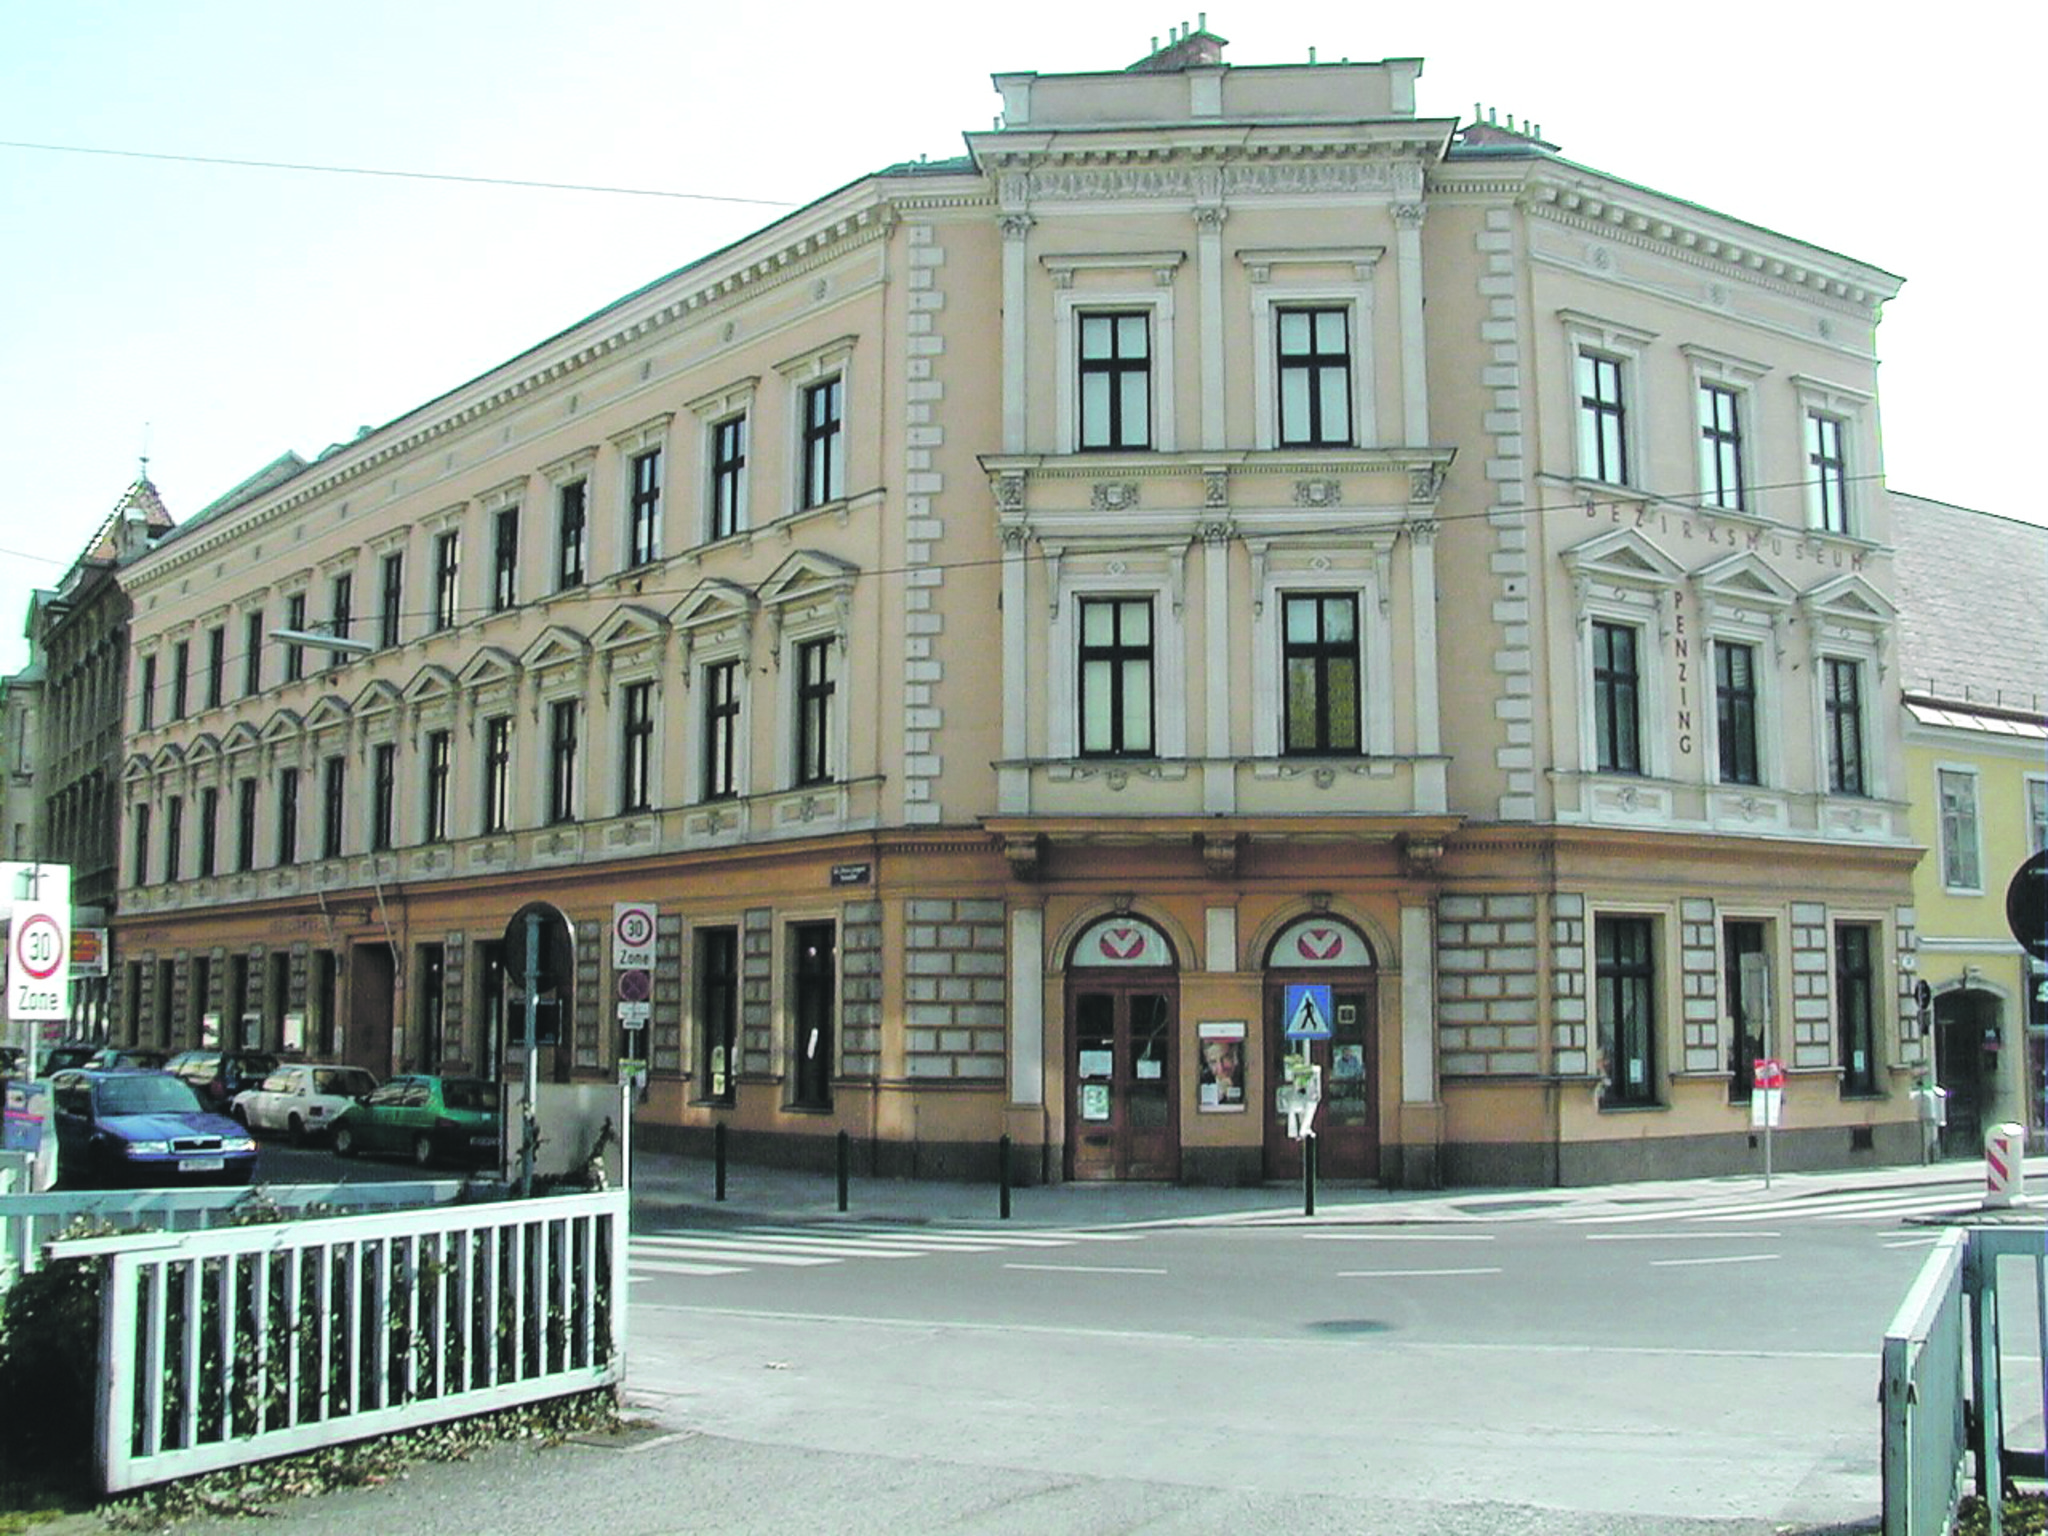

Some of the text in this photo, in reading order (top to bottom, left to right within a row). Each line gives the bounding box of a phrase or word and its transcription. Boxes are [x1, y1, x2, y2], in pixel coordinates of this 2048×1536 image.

[1586, 501, 1862, 572] BEZIRKSMUSEUM
[1674, 591, 1692, 754] PENZING
[628, 919, 643, 938] 30
[30, 931, 50, 961] 30
[620, 950, 649, 965] Zone
[18, 985, 58, 1010] Zone
